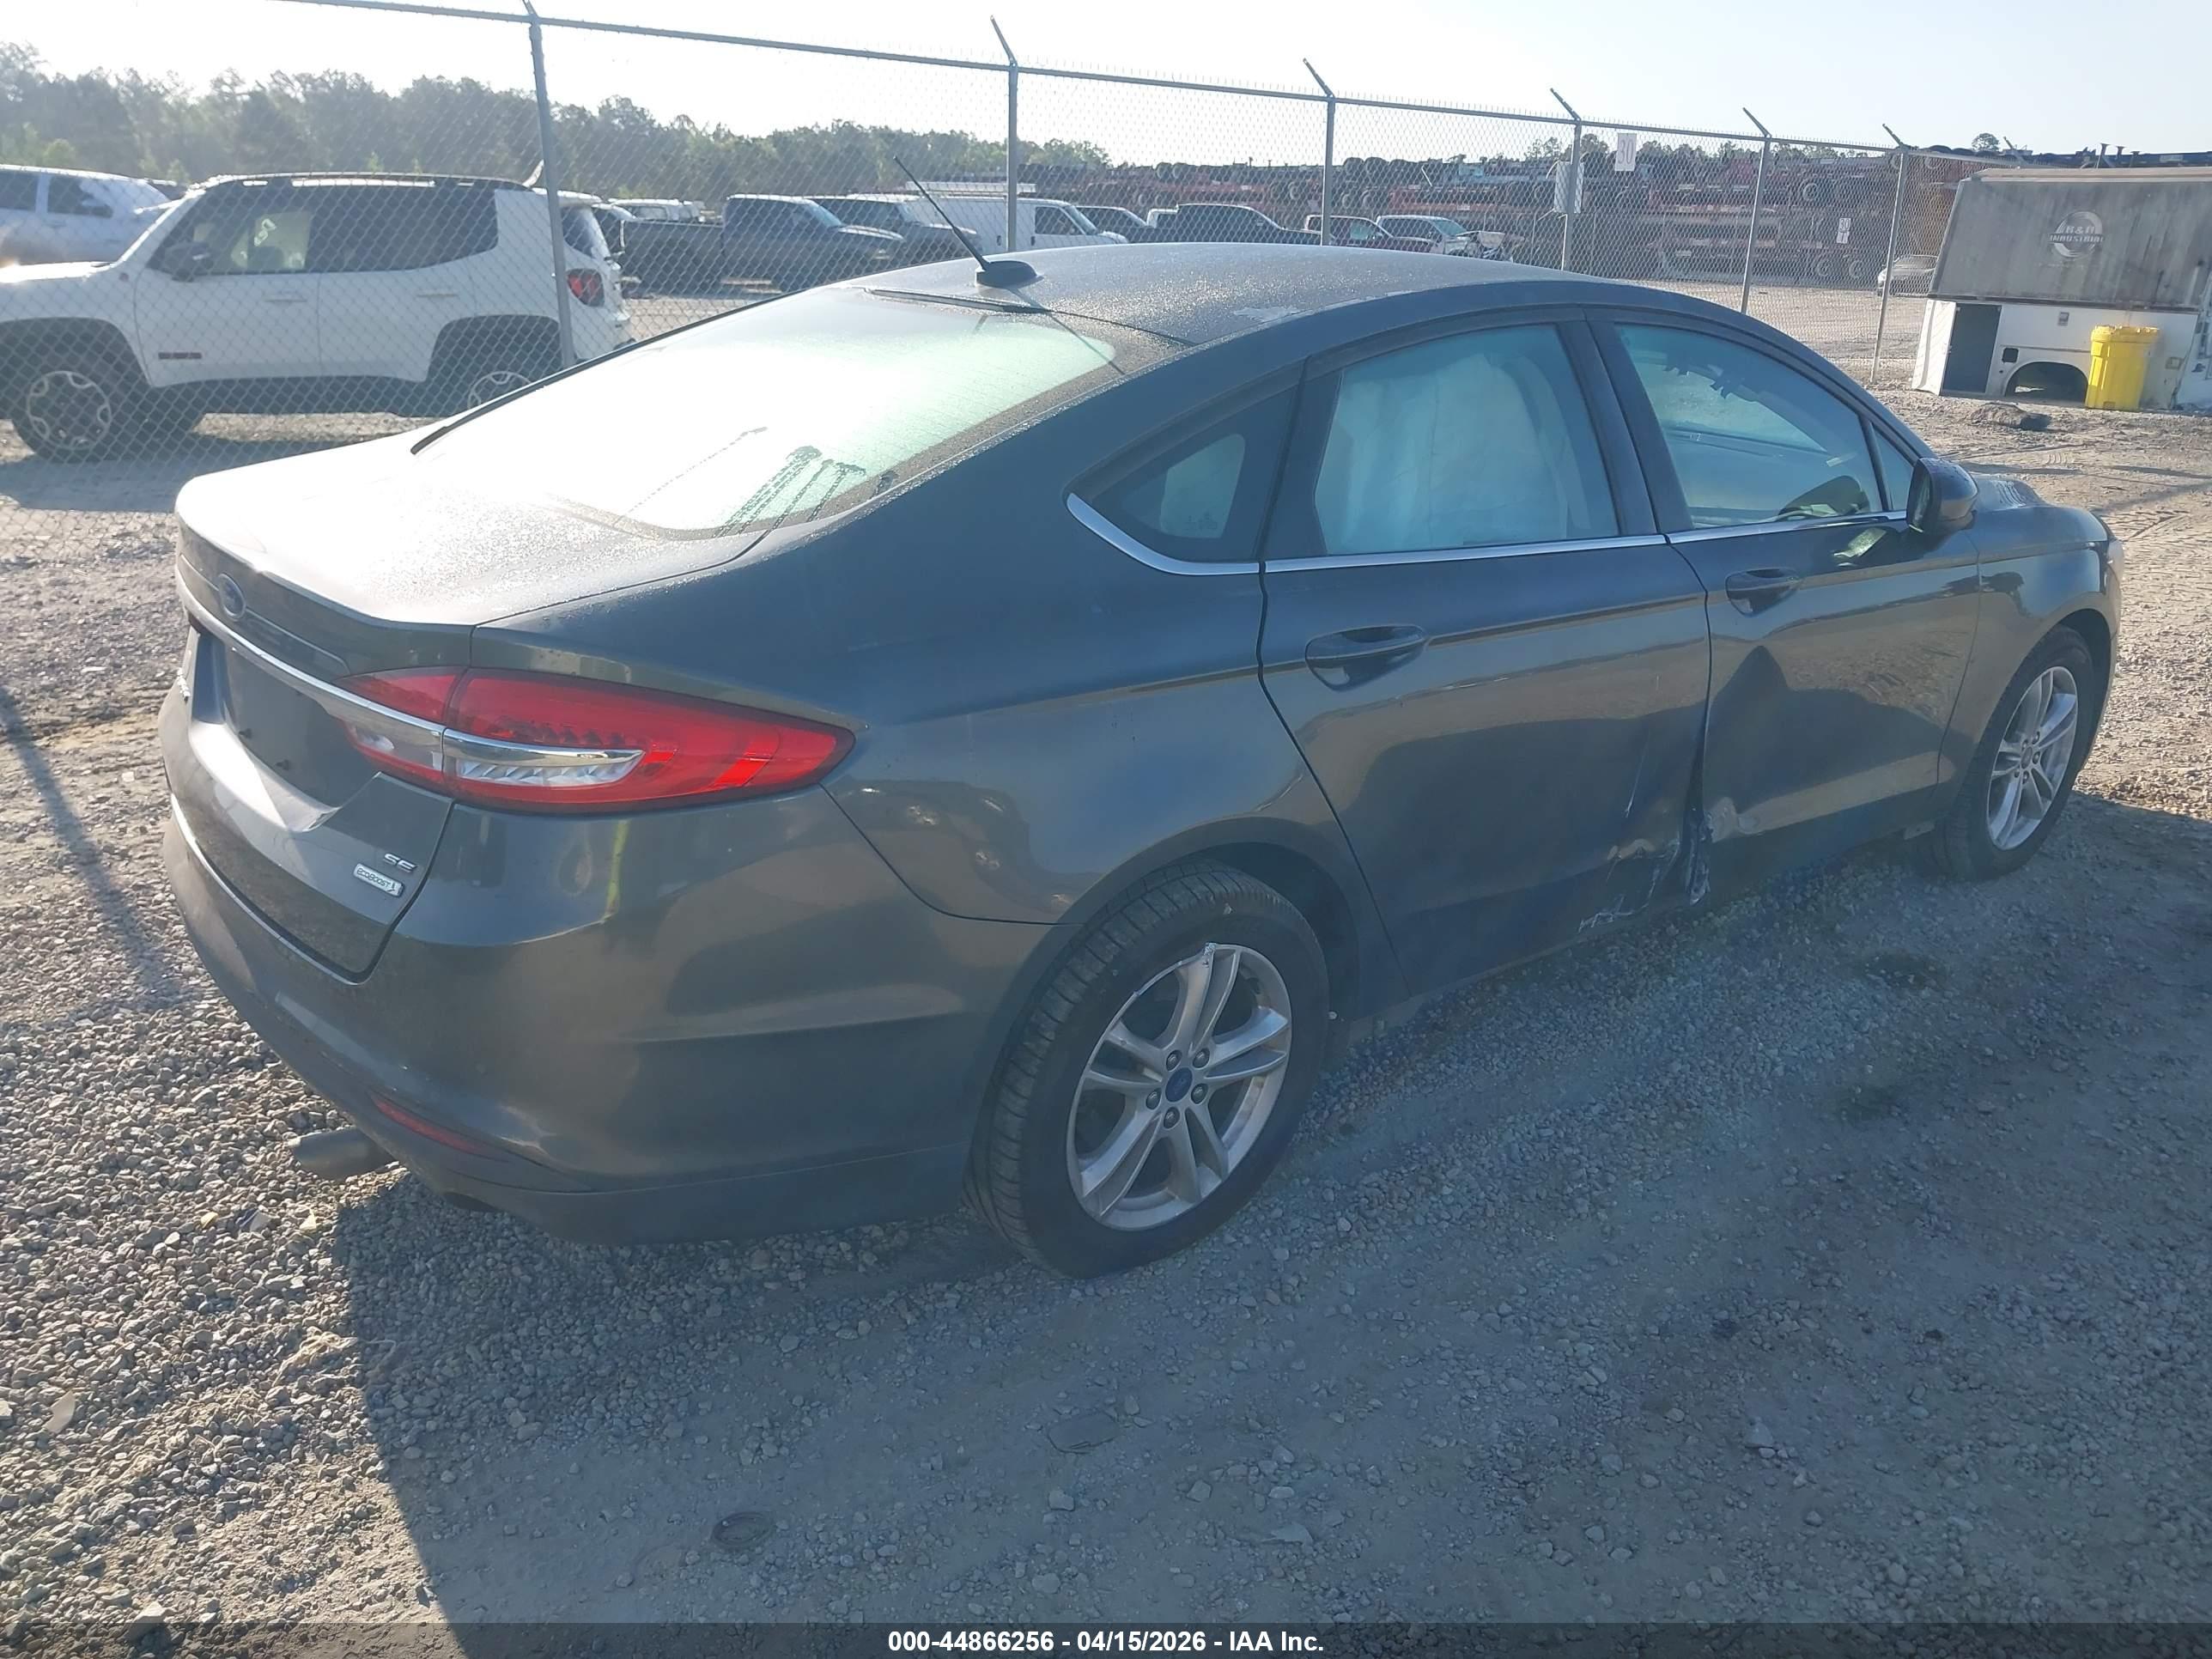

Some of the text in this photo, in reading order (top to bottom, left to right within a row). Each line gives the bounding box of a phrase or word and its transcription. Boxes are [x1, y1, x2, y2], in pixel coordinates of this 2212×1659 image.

[1618, 139, 1634, 164] 30
[1840, 218, 1850, 230] 30
[383, 853, 417, 873] SE
